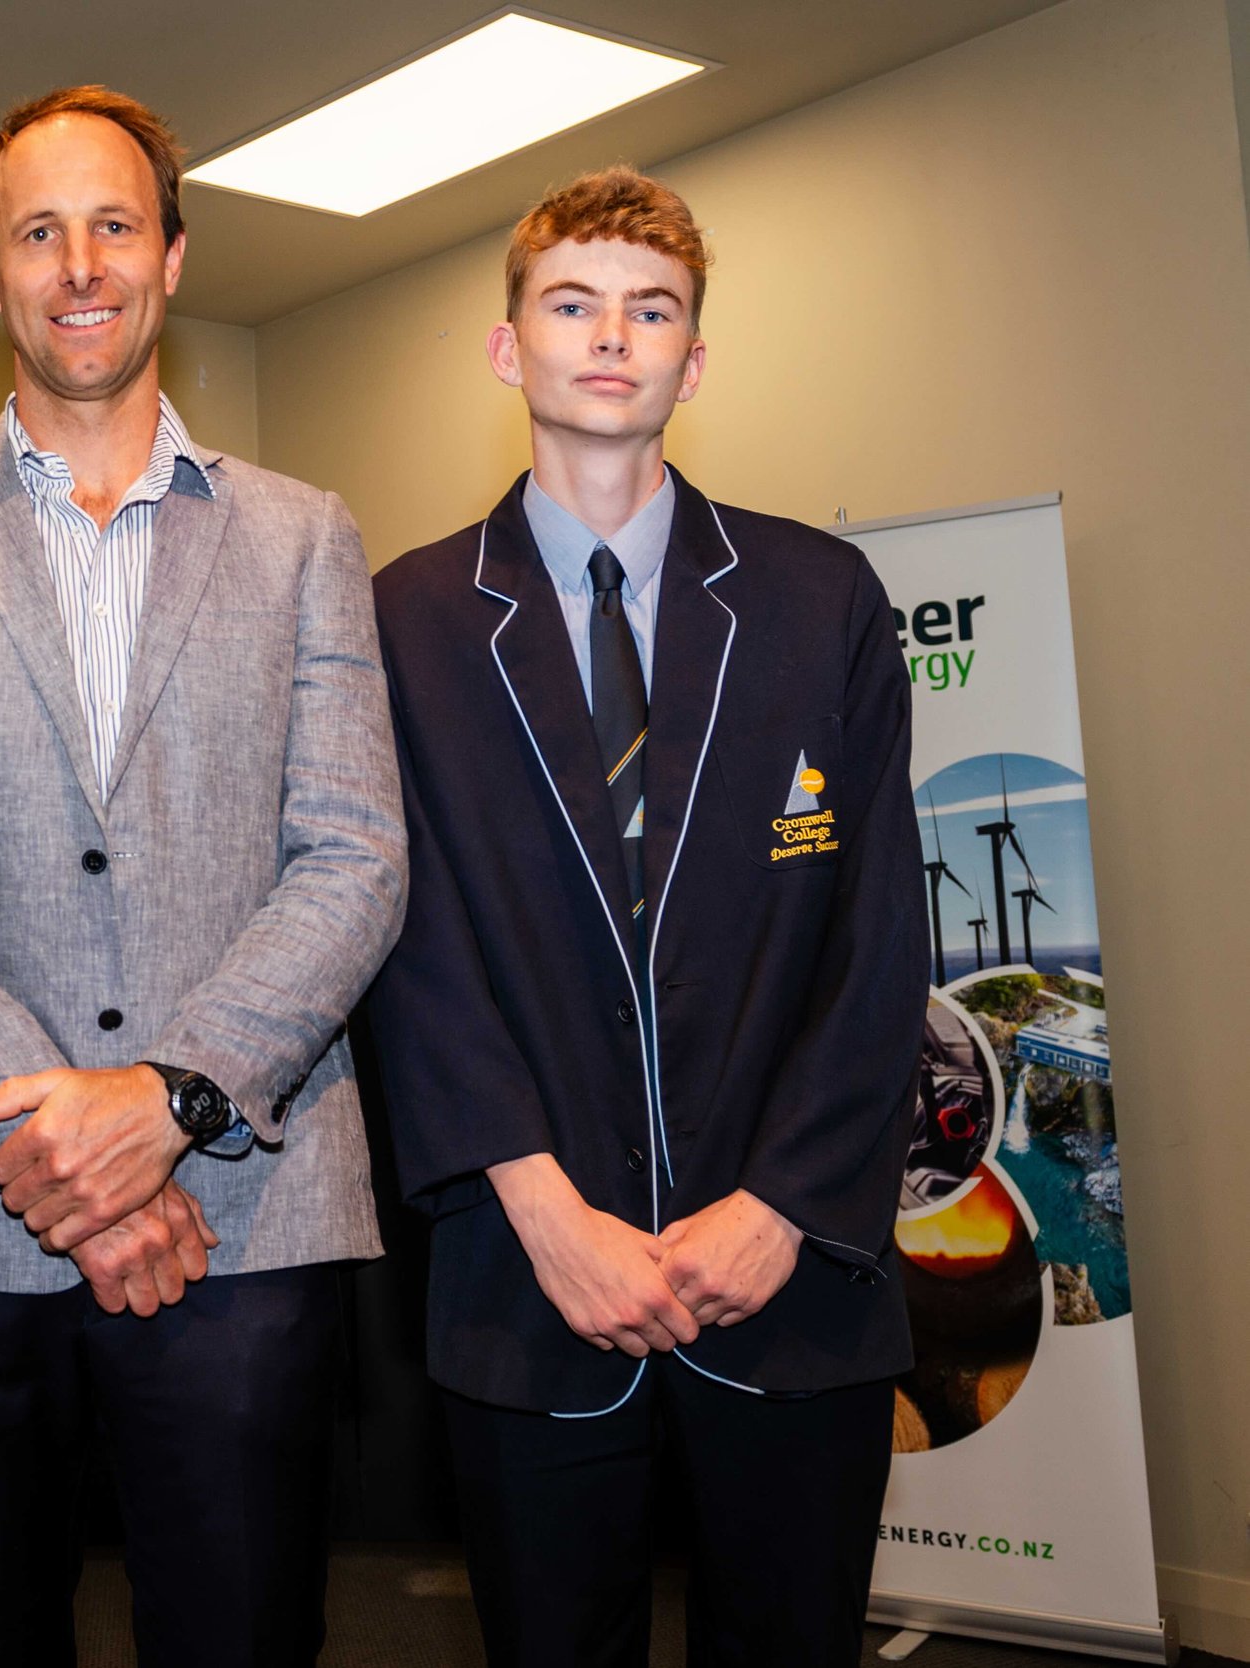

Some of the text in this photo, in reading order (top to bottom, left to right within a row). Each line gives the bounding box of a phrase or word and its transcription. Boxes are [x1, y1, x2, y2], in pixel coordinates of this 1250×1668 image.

[772, 809, 835, 833] Cromwell
[782, 826, 831, 843] College
[770, 843, 813, 862] Deserve
